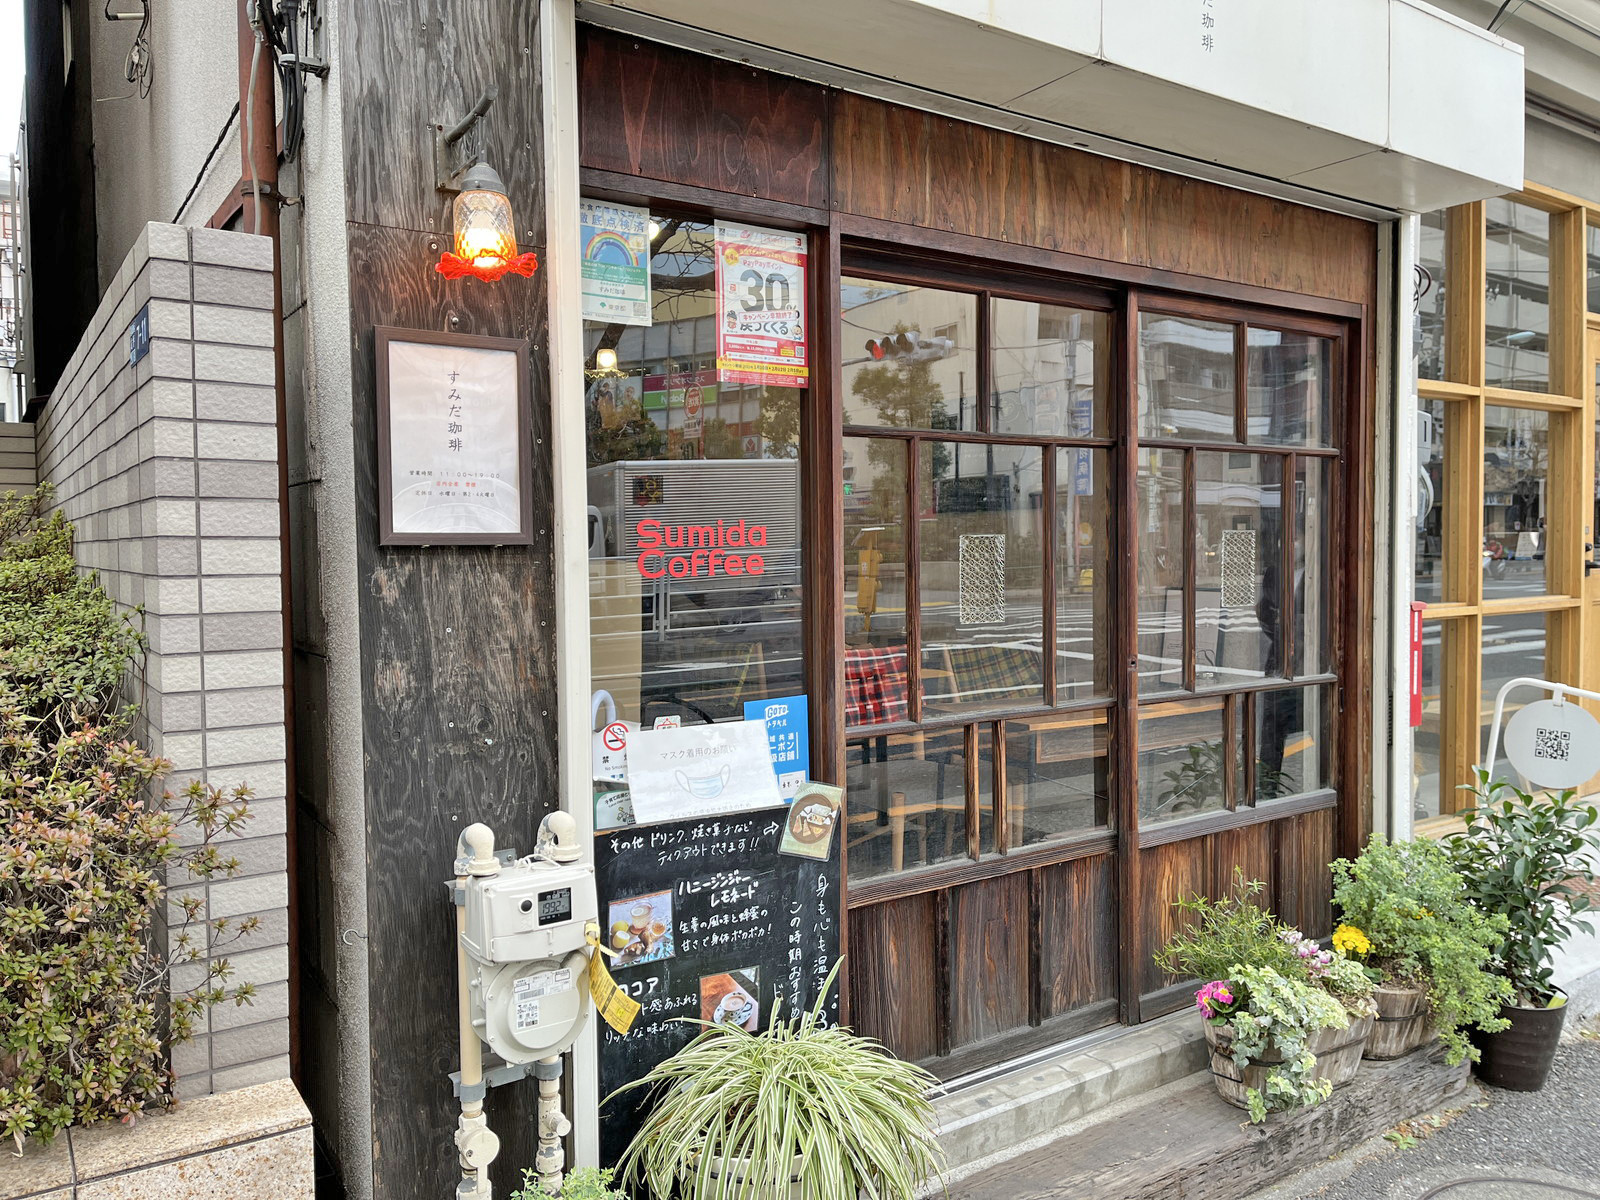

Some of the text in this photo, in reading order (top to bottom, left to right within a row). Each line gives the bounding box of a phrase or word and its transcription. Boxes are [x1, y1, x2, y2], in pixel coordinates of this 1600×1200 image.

[447, 370, 463, 452] すみだ珈琲
[636, 519, 767, 548] Sumida
[637, 549, 765, 579] Coffee
[769, 732, 794, 742] 域共通
[770, 741, 794, 751] ーポン
[660, 744, 737, 759] マスク着用のお願い
[772, 751, 795, 763] 扱店舗
[678, 868, 752, 896] ハニージンジャー
[710, 881, 760, 908] レモネード
[542, 900, 561, 914] 1992
